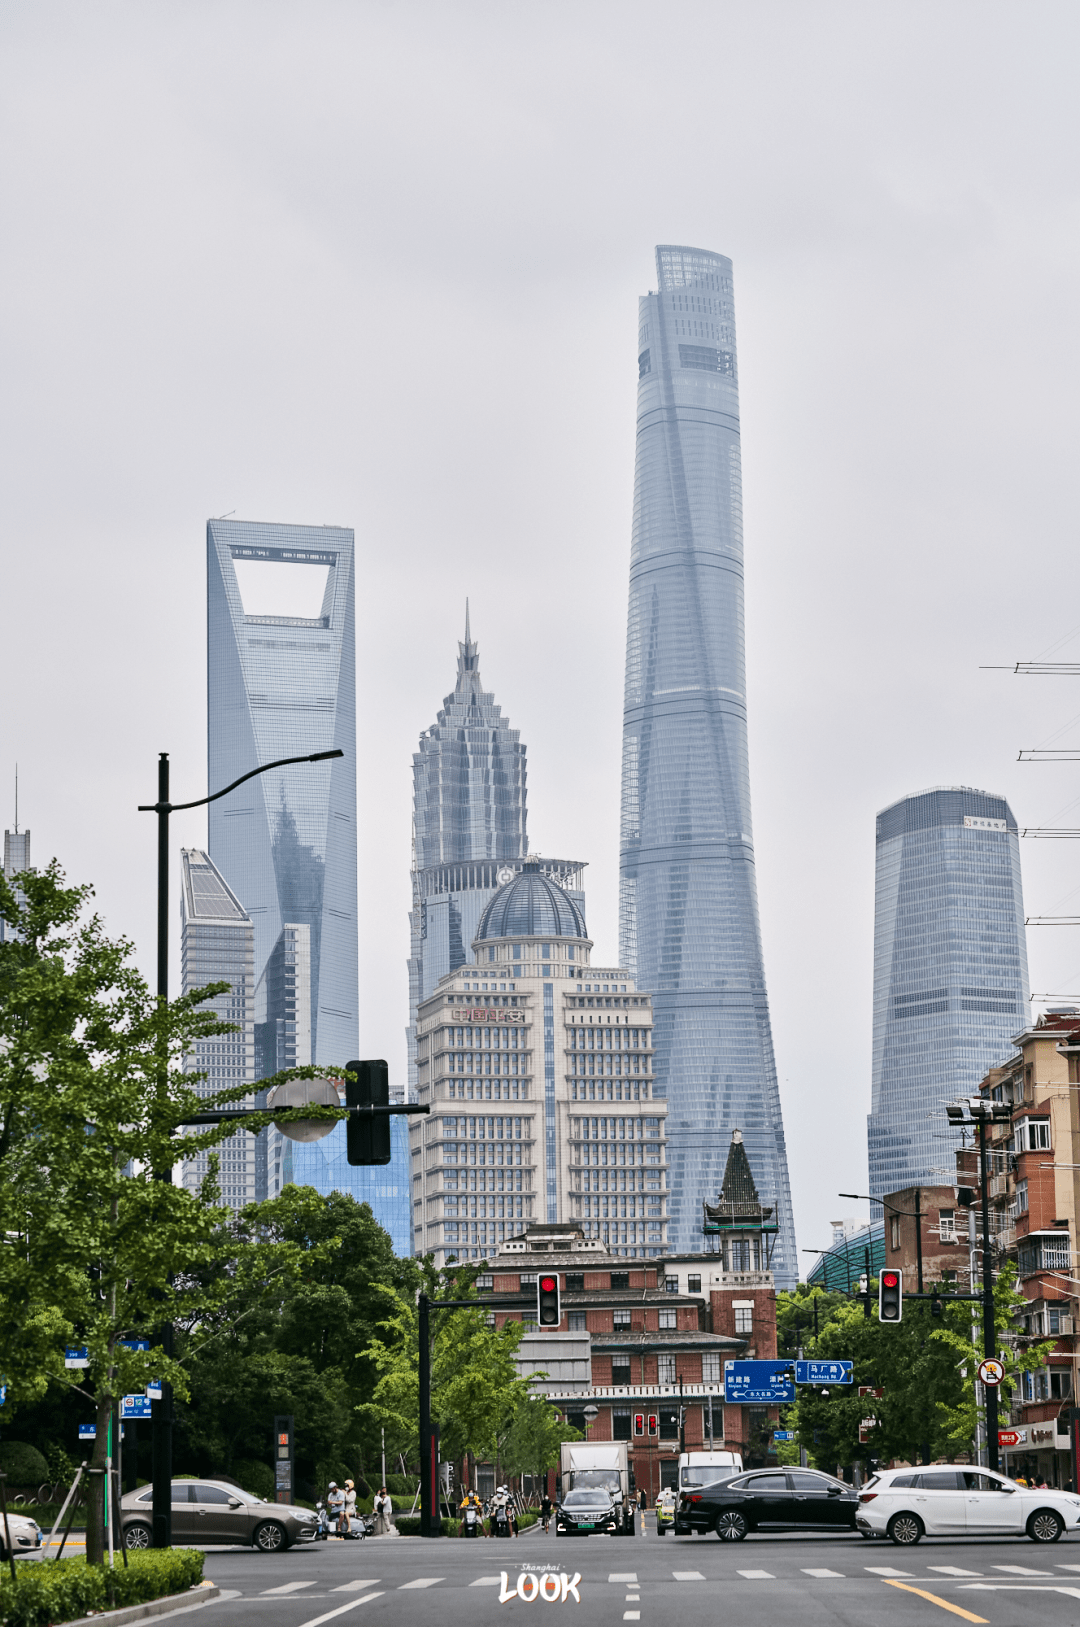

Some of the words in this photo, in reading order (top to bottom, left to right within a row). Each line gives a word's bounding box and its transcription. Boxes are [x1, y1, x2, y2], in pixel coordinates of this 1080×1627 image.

[452, 1007, 525, 1022] 中国平安
[810, 1364, 838, 1373] 马厂路
